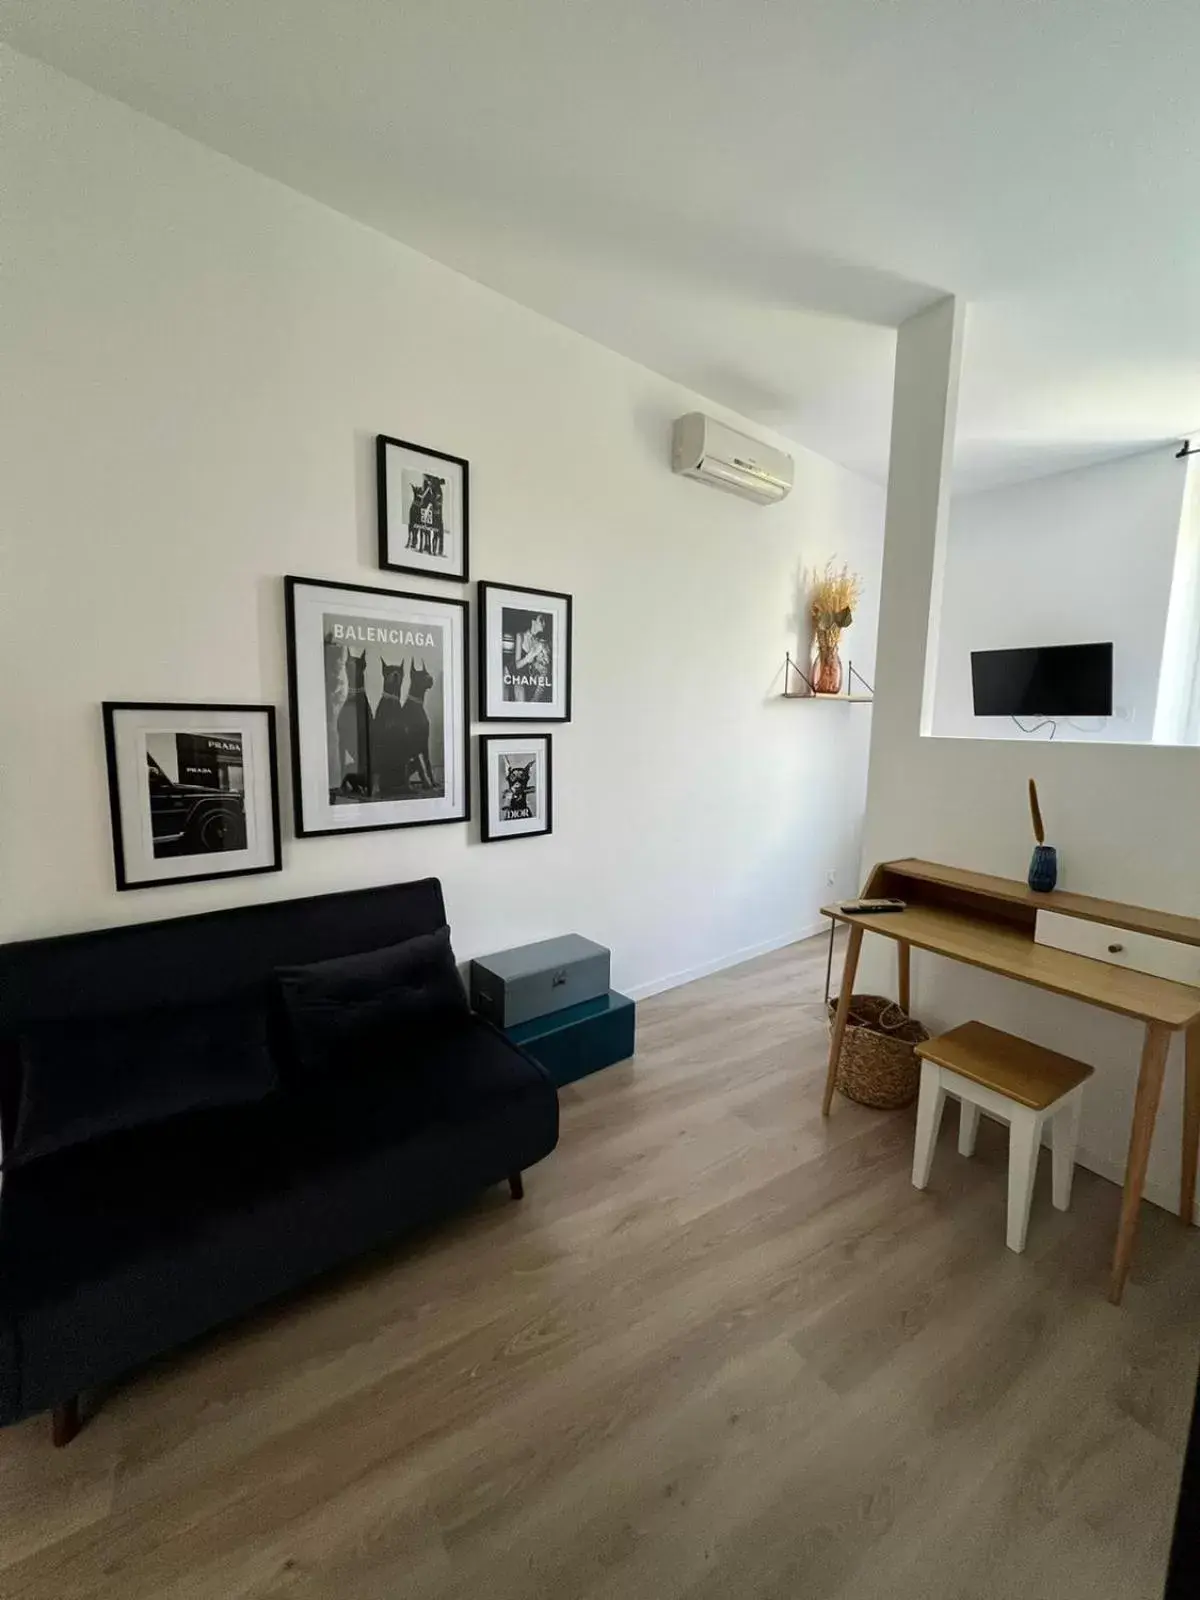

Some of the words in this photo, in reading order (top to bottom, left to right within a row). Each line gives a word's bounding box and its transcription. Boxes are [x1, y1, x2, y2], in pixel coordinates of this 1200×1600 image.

[334, 624, 434, 647] BALENCIAGA
[503, 674, 552, 687] CHANEL
[208, 740, 241, 751] PRADA
[507, 809, 530, 819] DIOR
